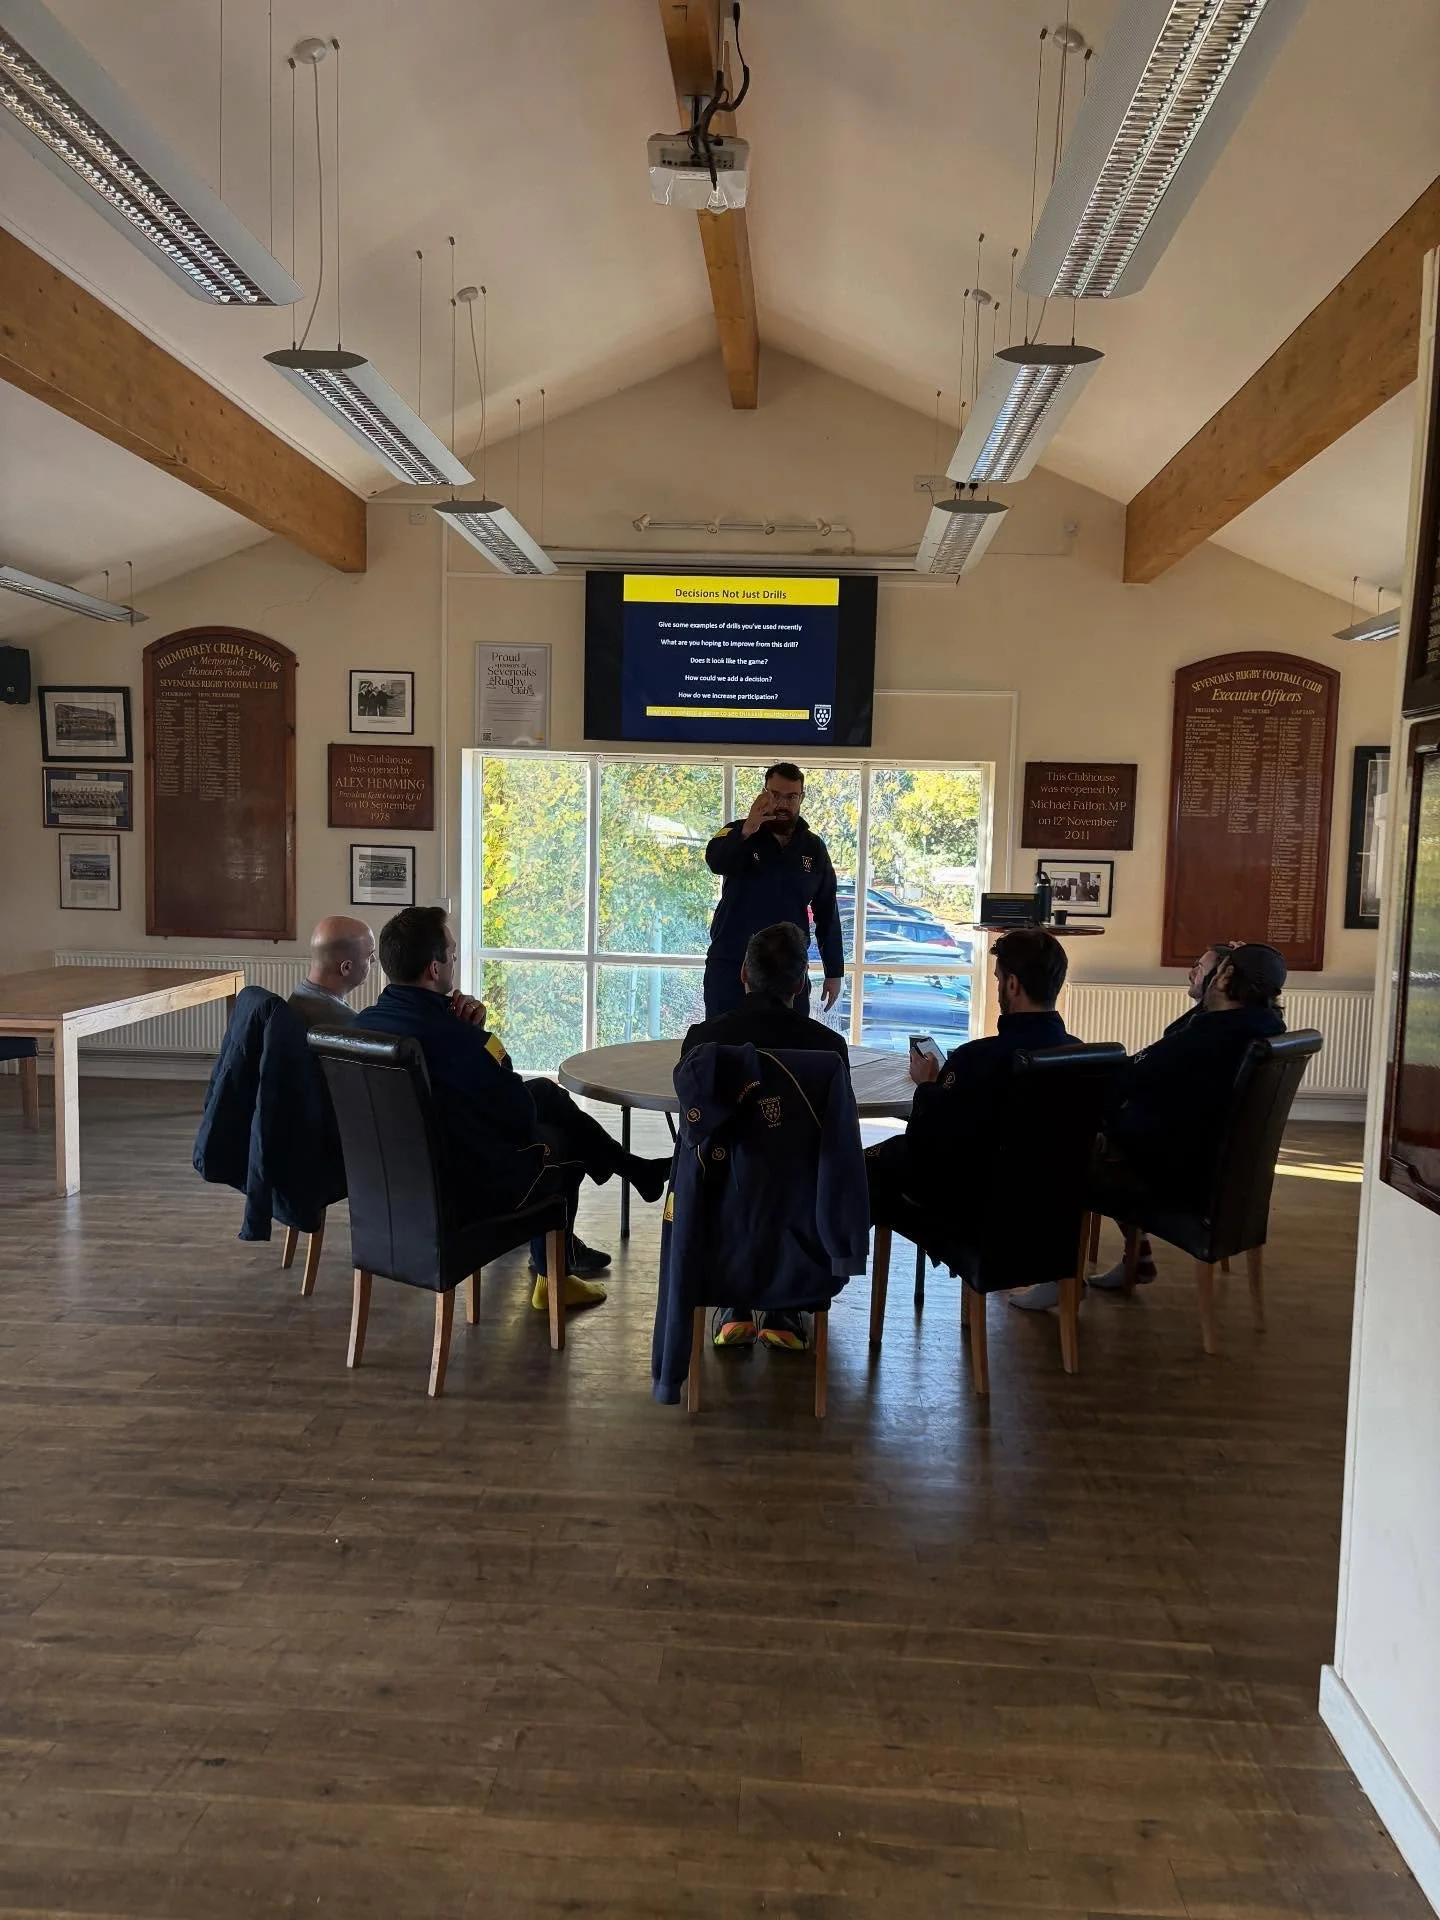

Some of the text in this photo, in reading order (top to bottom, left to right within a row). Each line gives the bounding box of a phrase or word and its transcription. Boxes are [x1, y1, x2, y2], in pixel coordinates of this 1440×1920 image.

[676, 588, 786, 599] Decisions Not Just Drills
[690, 622, 718, 630] examples
[156, 643, 281, 672] HUMPHREY CRUM-EWING
[200, 656, 240, 666] Memorial
[492, 652, 520, 662] Proud
[224, 666, 252, 677] Board
[487, 666, 537, 677] Sevenoaks
[160, 679, 278, 689] SEVENOAKS RUGBY FOOTBALL CLUB
[494, 676, 524, 687] Rugby
[1192, 670, 1323, 694] SEVENOAKS RUGBY FOOTBALL CLUB
[510, 686, 529, 695] Club
[1211, 688, 1303, 707] Executive Officers
[348, 753, 413, 765] This Clubhouse
[368, 766, 400, 775] opened
[400, 766, 411, 776] by
[1048, 772, 1116, 782] This Clubhouse
[335, 776, 425, 790] ALEX HEMMING
[1060, 785, 1105, 796] reopened
[1107, 785, 1120, 796] by
[371, 801, 417, 811] September
[1030, 799, 1070, 810] Michael
[1108, 801, 1127, 811] MP
[1067, 816, 1118, 826] November
[1064, 830, 1090, 840] 2011
